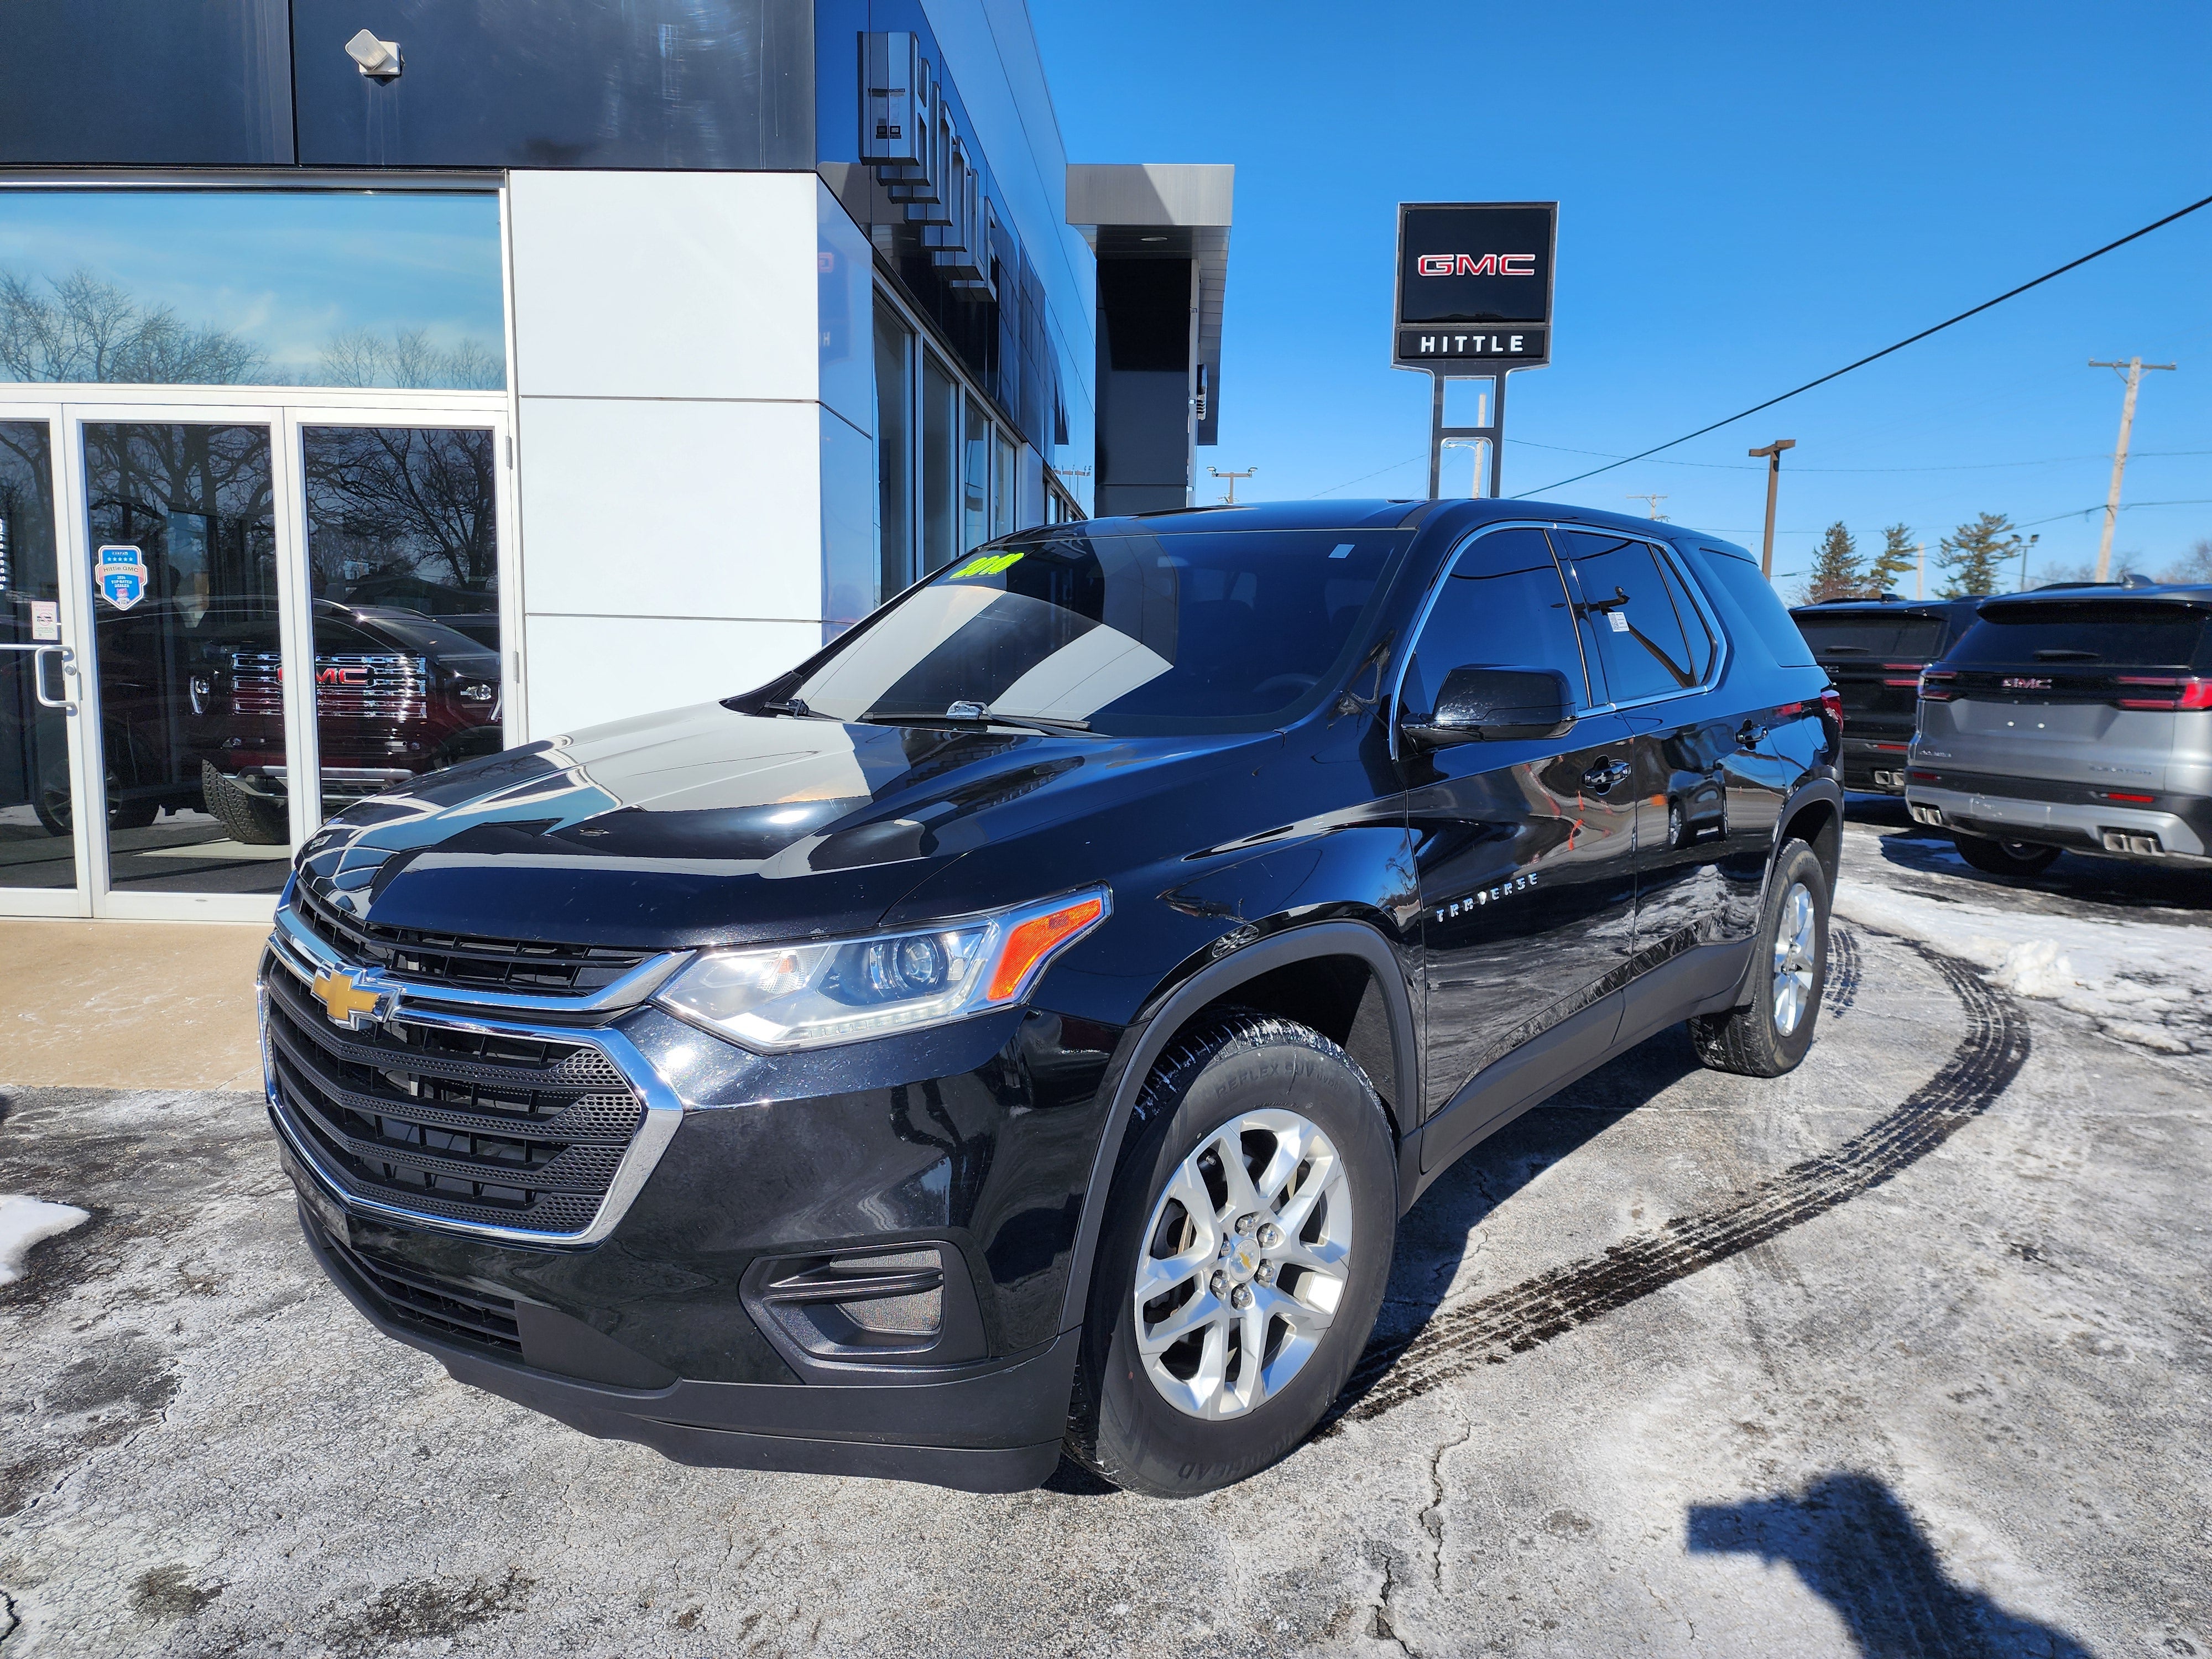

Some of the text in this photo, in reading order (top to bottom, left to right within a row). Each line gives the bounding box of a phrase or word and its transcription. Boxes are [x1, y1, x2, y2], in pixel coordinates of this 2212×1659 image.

[1417, 253, 1536, 276] GMC
[1420, 335, 1524, 353] HITTLE
[277, 667, 368, 685] MC
[1436, 873, 1538, 922] TRAVERSE
